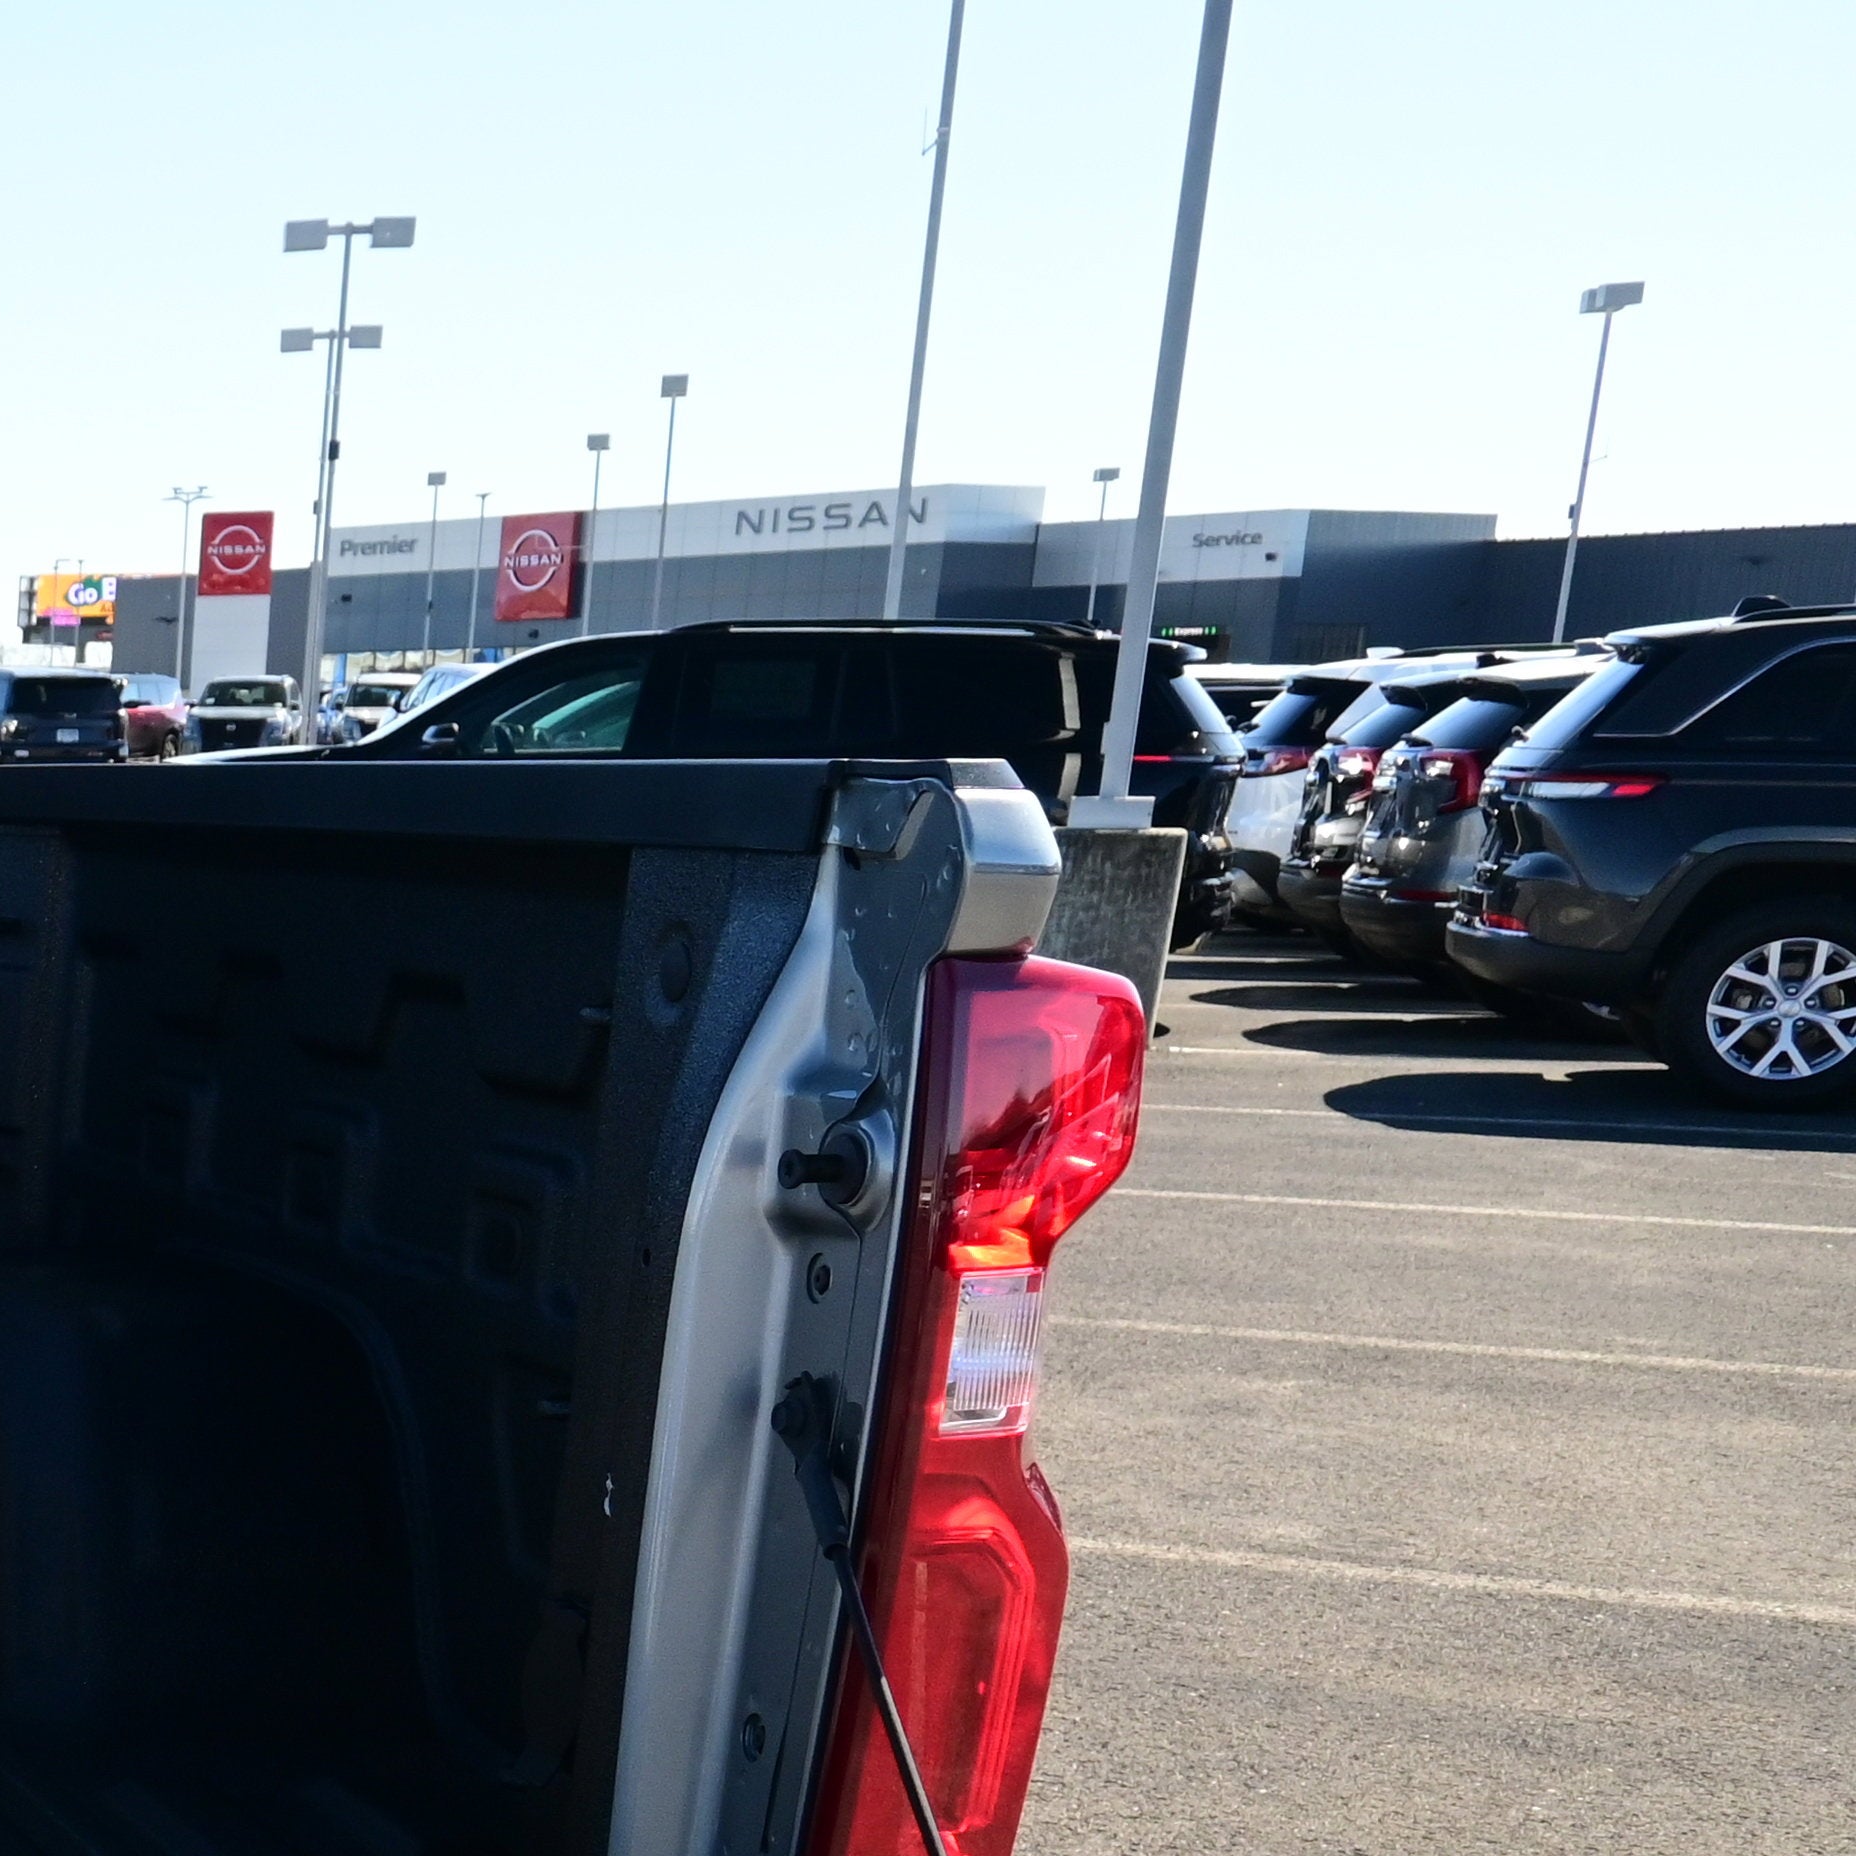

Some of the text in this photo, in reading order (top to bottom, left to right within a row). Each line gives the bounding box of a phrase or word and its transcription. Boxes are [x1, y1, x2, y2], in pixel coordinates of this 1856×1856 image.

[735, 497, 928, 535] NISSAN
[340, 534, 418, 557] Premier
[1192, 529, 1263, 548] Service
[207, 544, 266, 555] NISSAN
[504, 553, 562, 568] NISSAN
